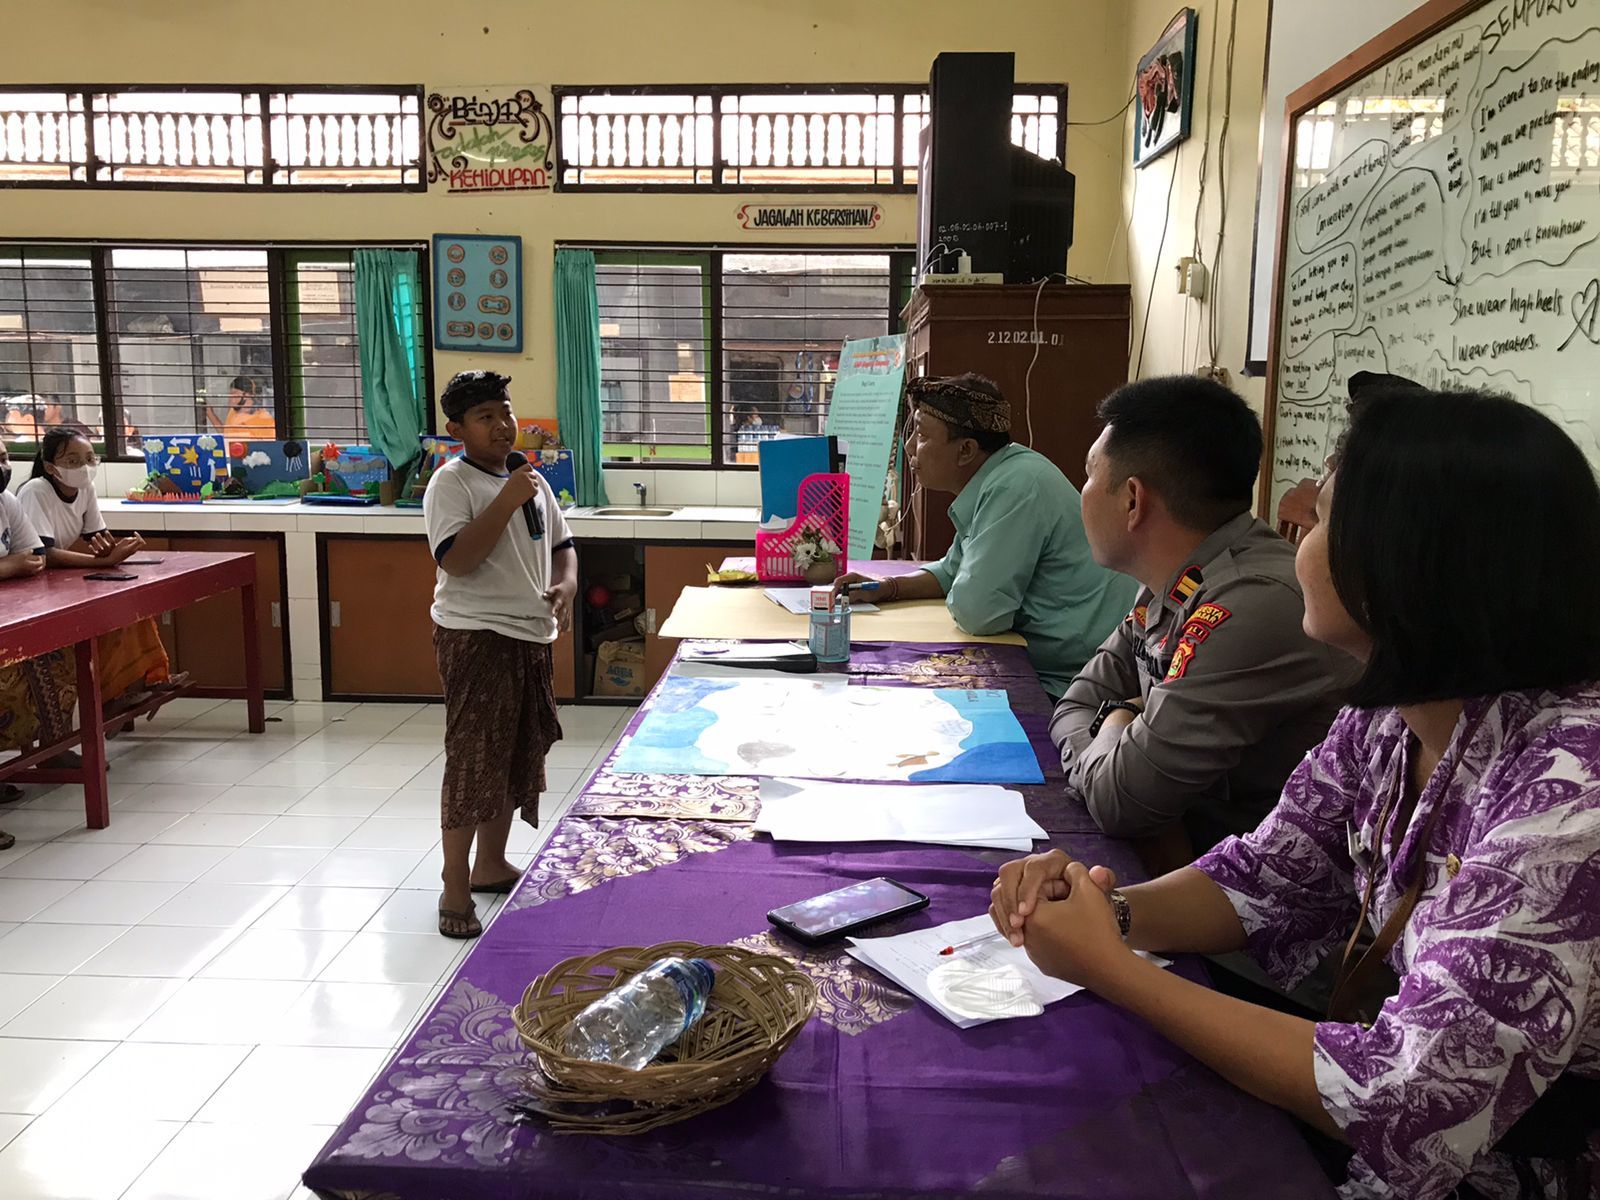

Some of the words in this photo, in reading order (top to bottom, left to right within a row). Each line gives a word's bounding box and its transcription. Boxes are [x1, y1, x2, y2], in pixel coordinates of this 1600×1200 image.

[1555, 71, 1570, 91] the
[754, 208, 804, 227] JAGALAH
[1470, 237, 1492, 265] But
[1450, 297, 1474, 325] She
[1476, 298, 1507, 316] wear
[1452, 335, 1457, 362] I
[1458, 343, 1489, 361] wear
